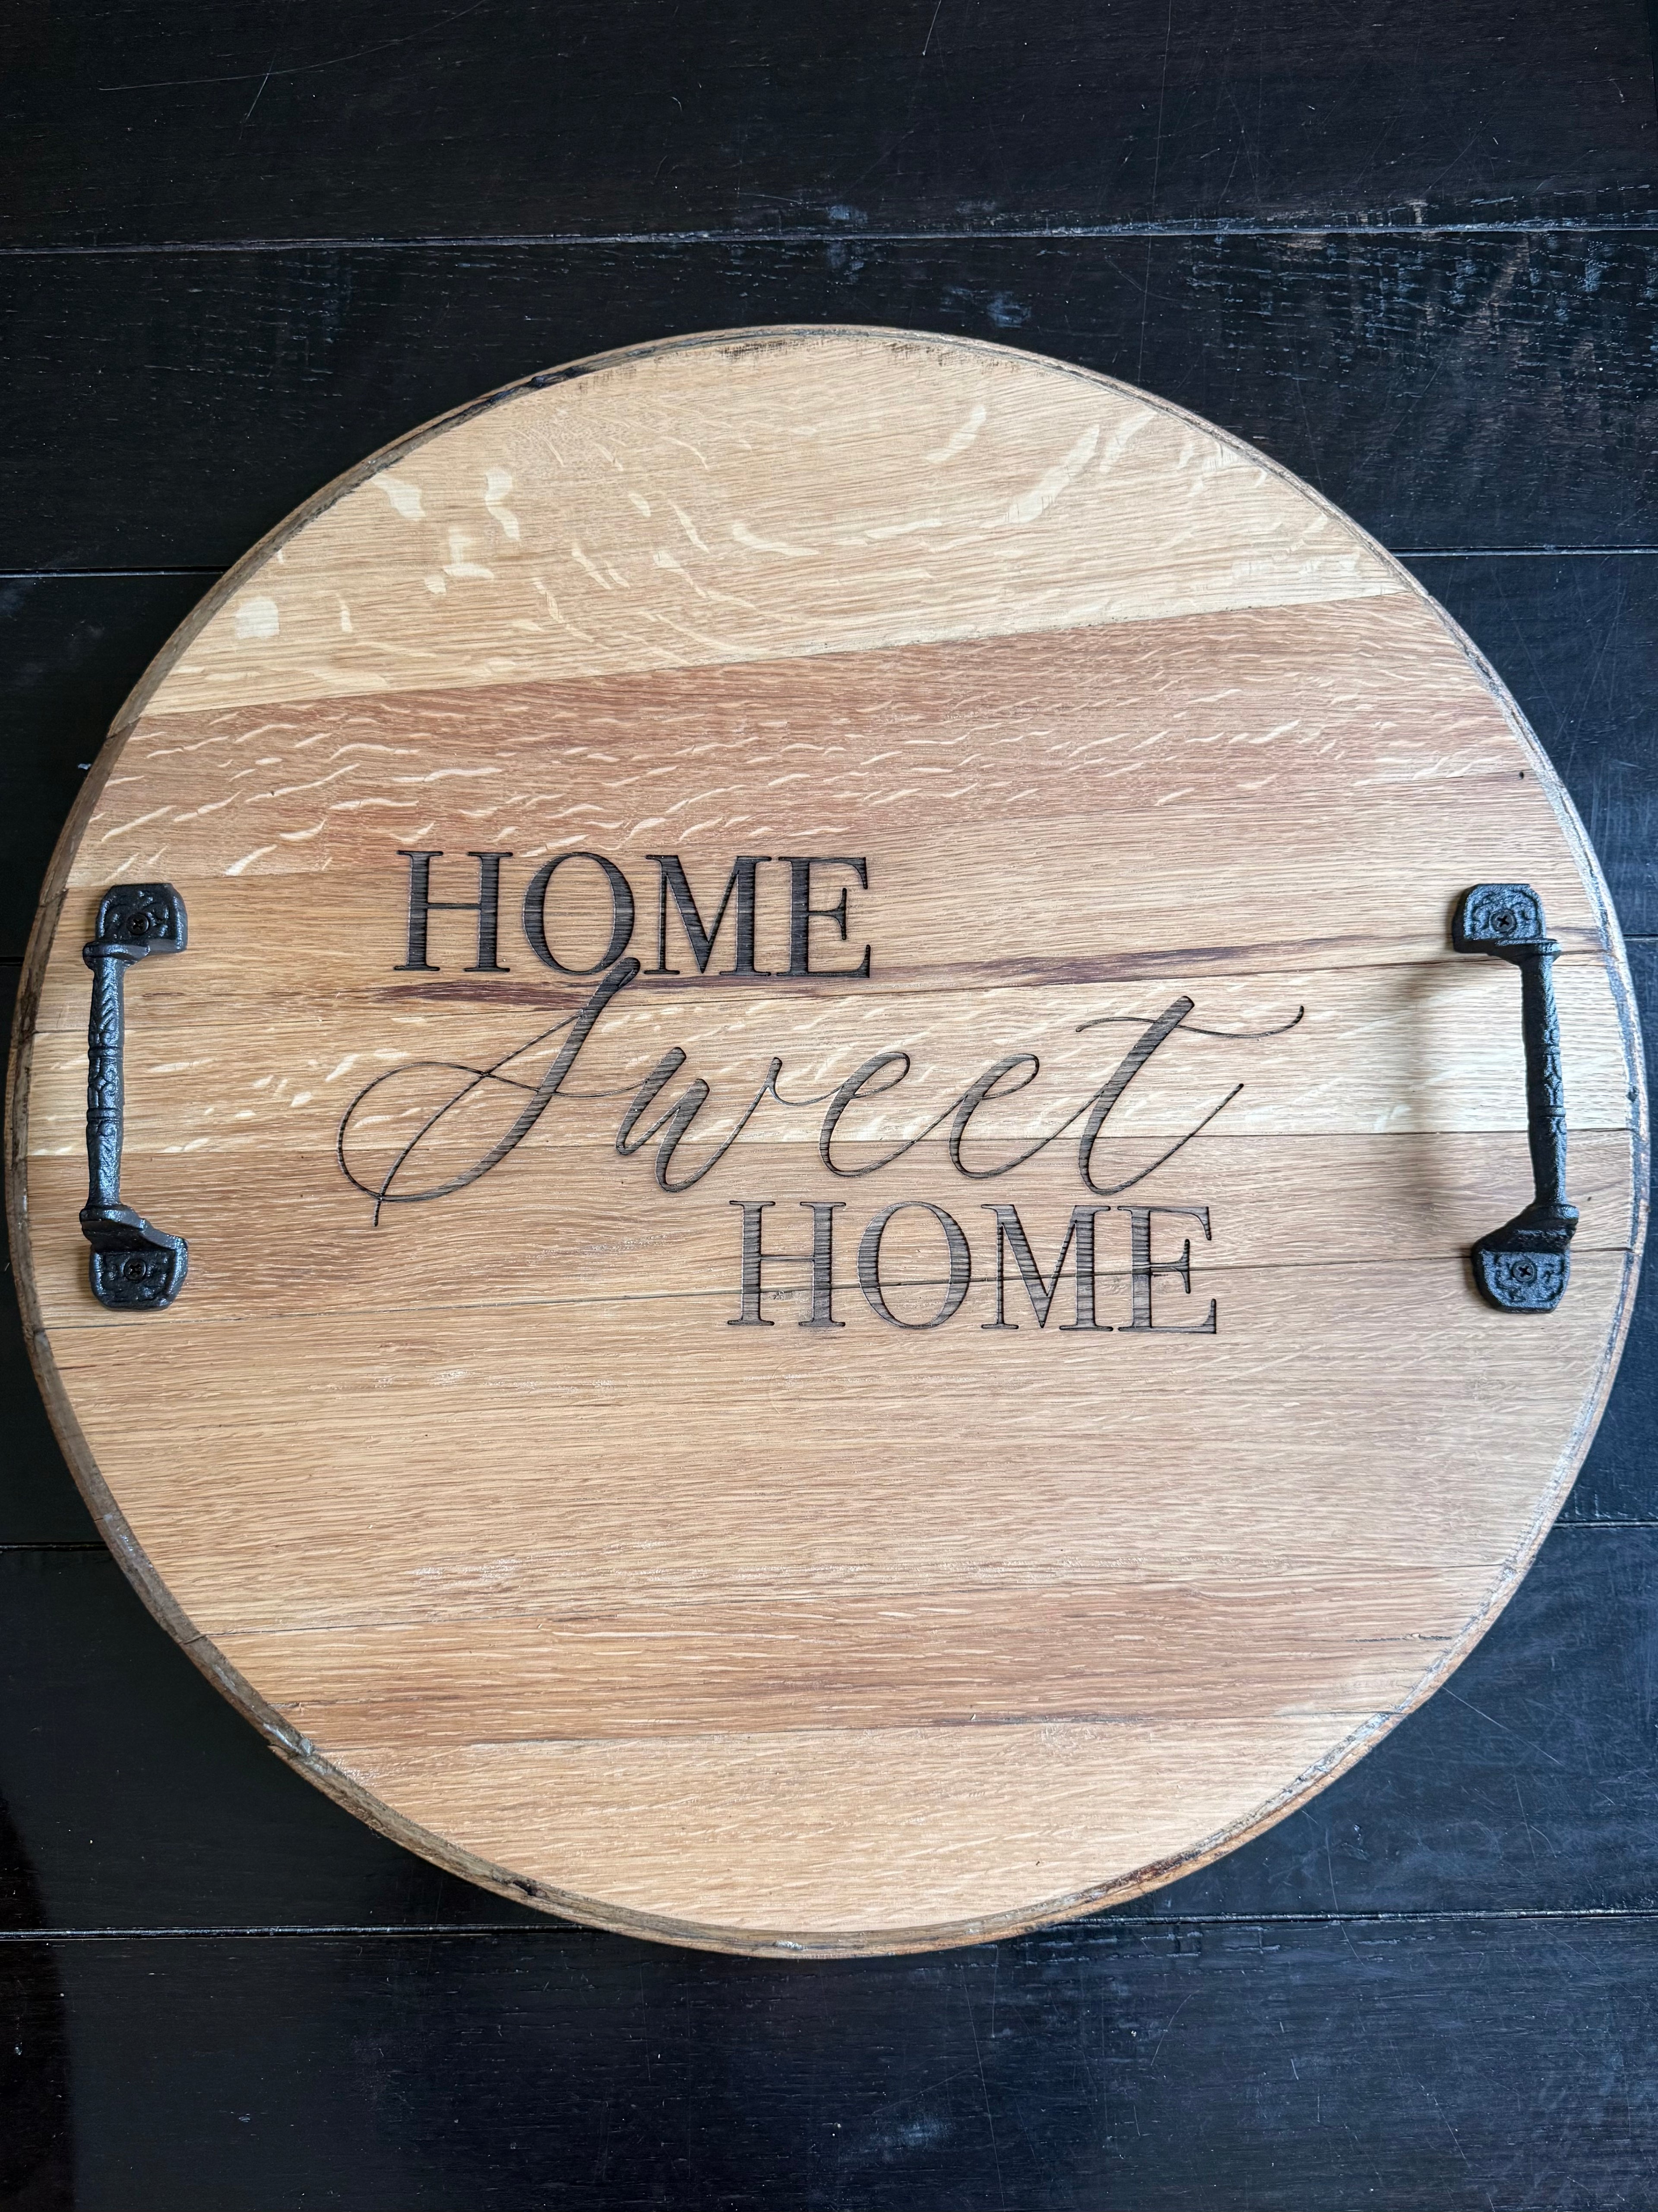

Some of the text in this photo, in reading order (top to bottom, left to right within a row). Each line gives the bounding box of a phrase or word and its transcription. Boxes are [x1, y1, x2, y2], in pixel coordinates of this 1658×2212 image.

[393, 850, 870, 978] HOME
[336, 957, 1305, 1227] Sweet
[727, 1200, 1217, 1334] HOME
